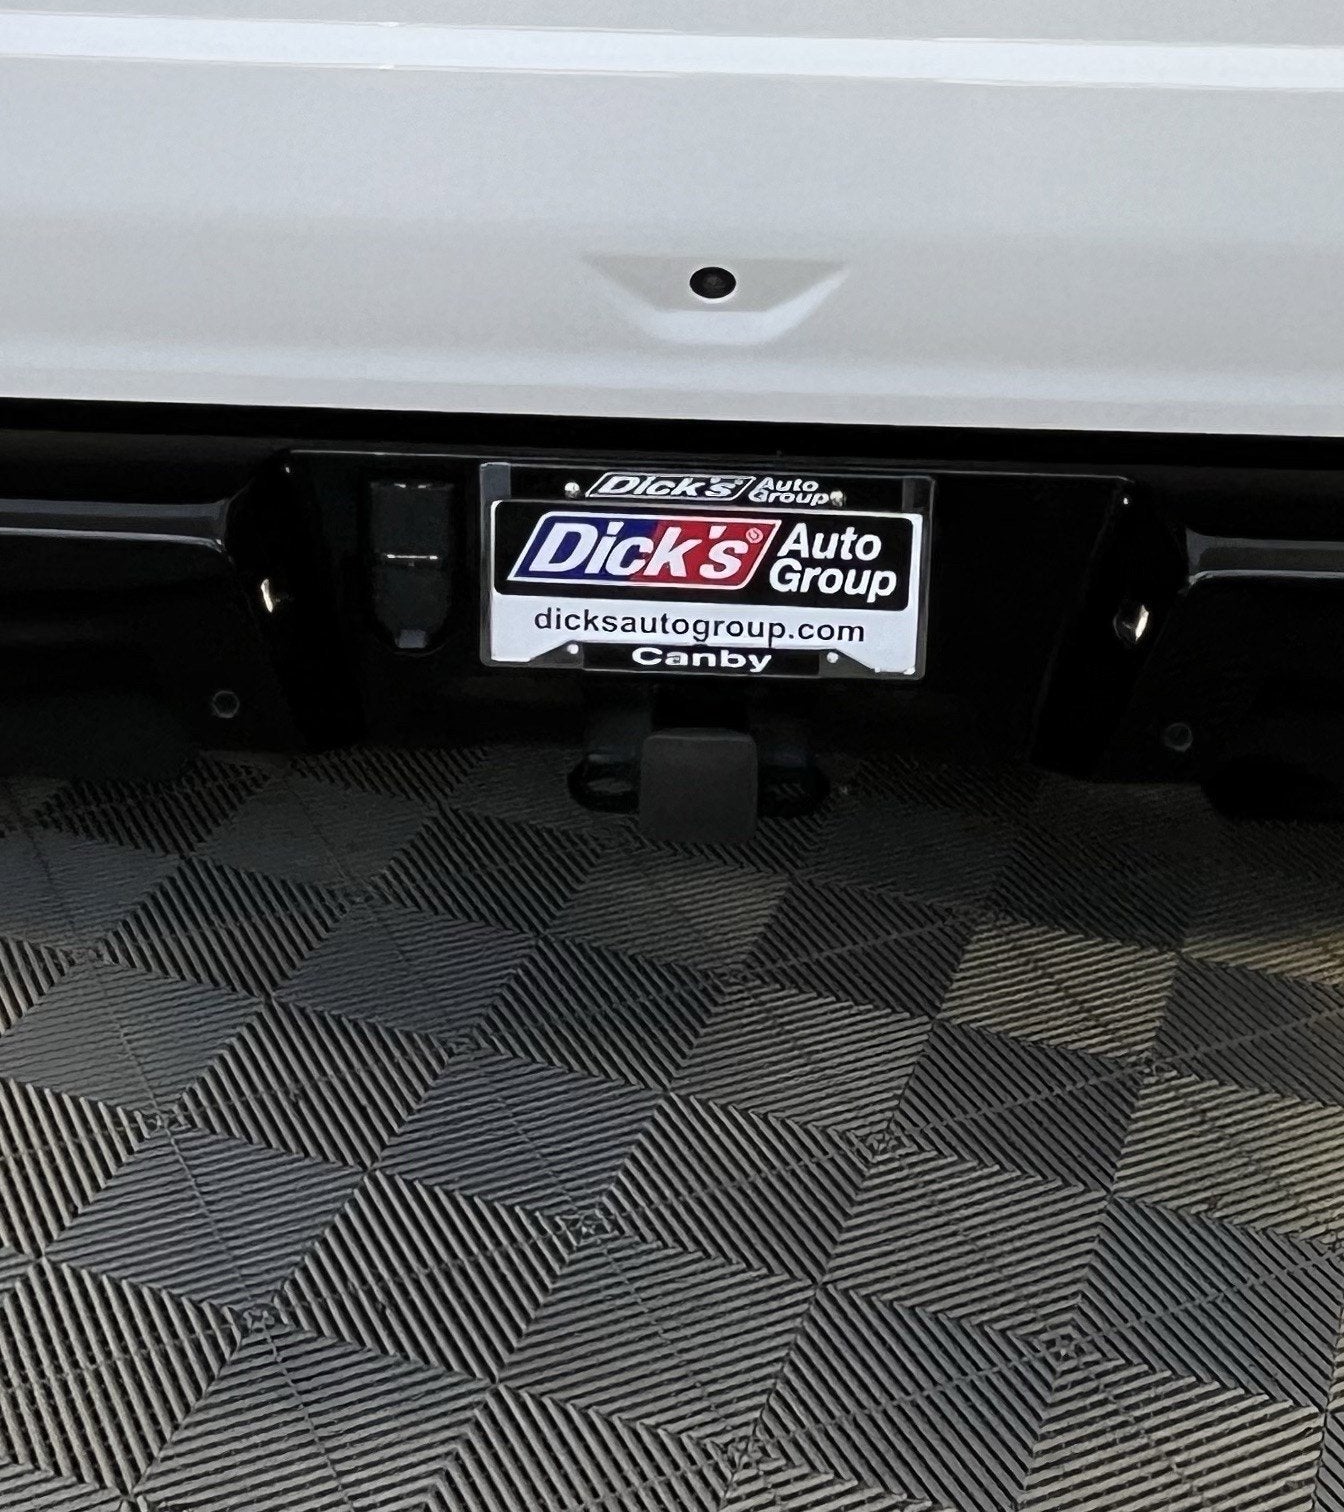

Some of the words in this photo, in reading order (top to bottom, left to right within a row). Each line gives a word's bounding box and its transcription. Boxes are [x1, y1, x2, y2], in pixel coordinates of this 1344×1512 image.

[748, 488, 830, 506] Group
[754, 477, 820, 492] Auto
[777, 522, 882, 561] Auto
[769, 558, 898, 603] Group
[533, 607, 866, 646] dicksautogroup.com
[631, 647, 773, 672] Canby
